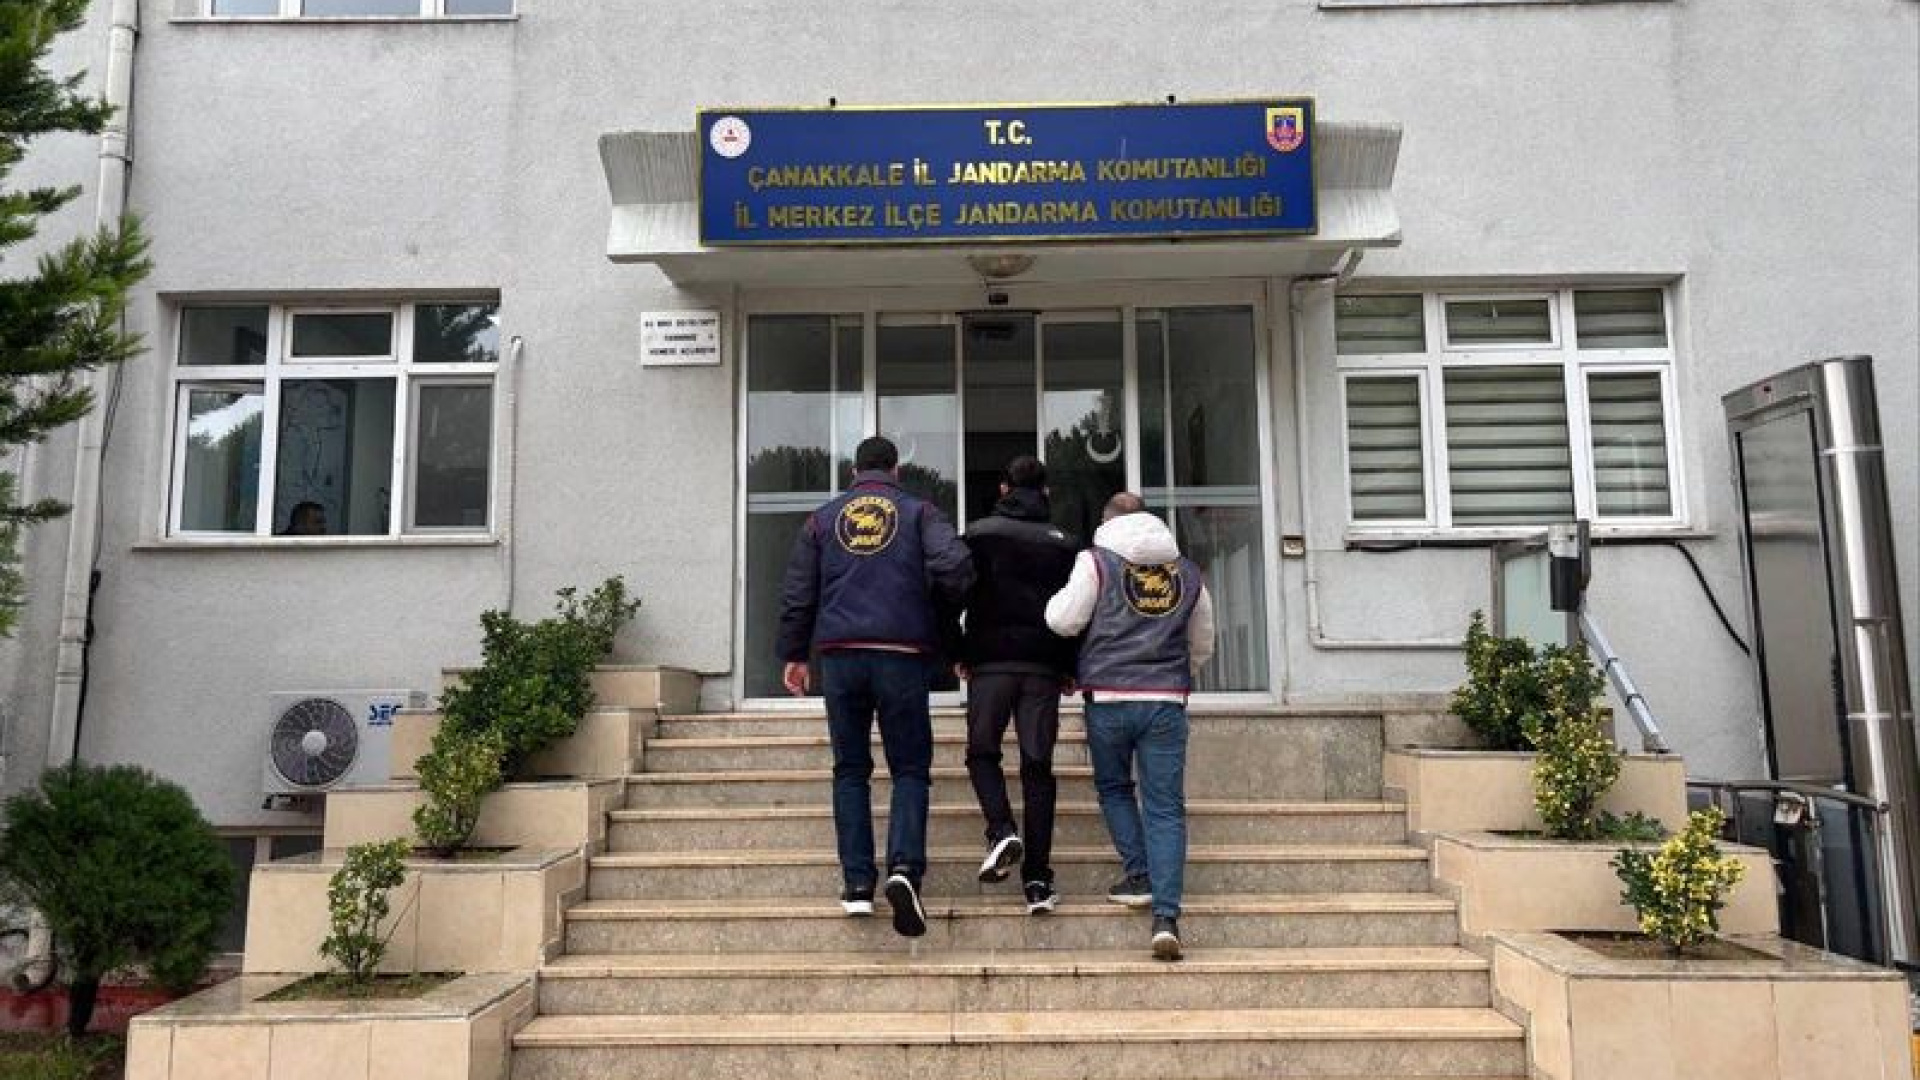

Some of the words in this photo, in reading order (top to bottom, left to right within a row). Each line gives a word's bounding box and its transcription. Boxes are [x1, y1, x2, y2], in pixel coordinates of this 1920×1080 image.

[984, 118, 1033, 145] T.C.
[749, 162, 904, 192] ÇANAKKALE
[913, 157, 937, 186] İL
[947, 160, 1087, 185] JANDARMA
[1097, 150, 1267, 181] KOMUTANLIĞI
[734, 201, 758, 229] İL
[767, 205, 875, 228] MERKEZ
[884, 201, 942, 230] İLÇE
[954, 200, 1099, 225] JANDARMA
[1110, 192, 1283, 222] KOMUTANLIĞI
